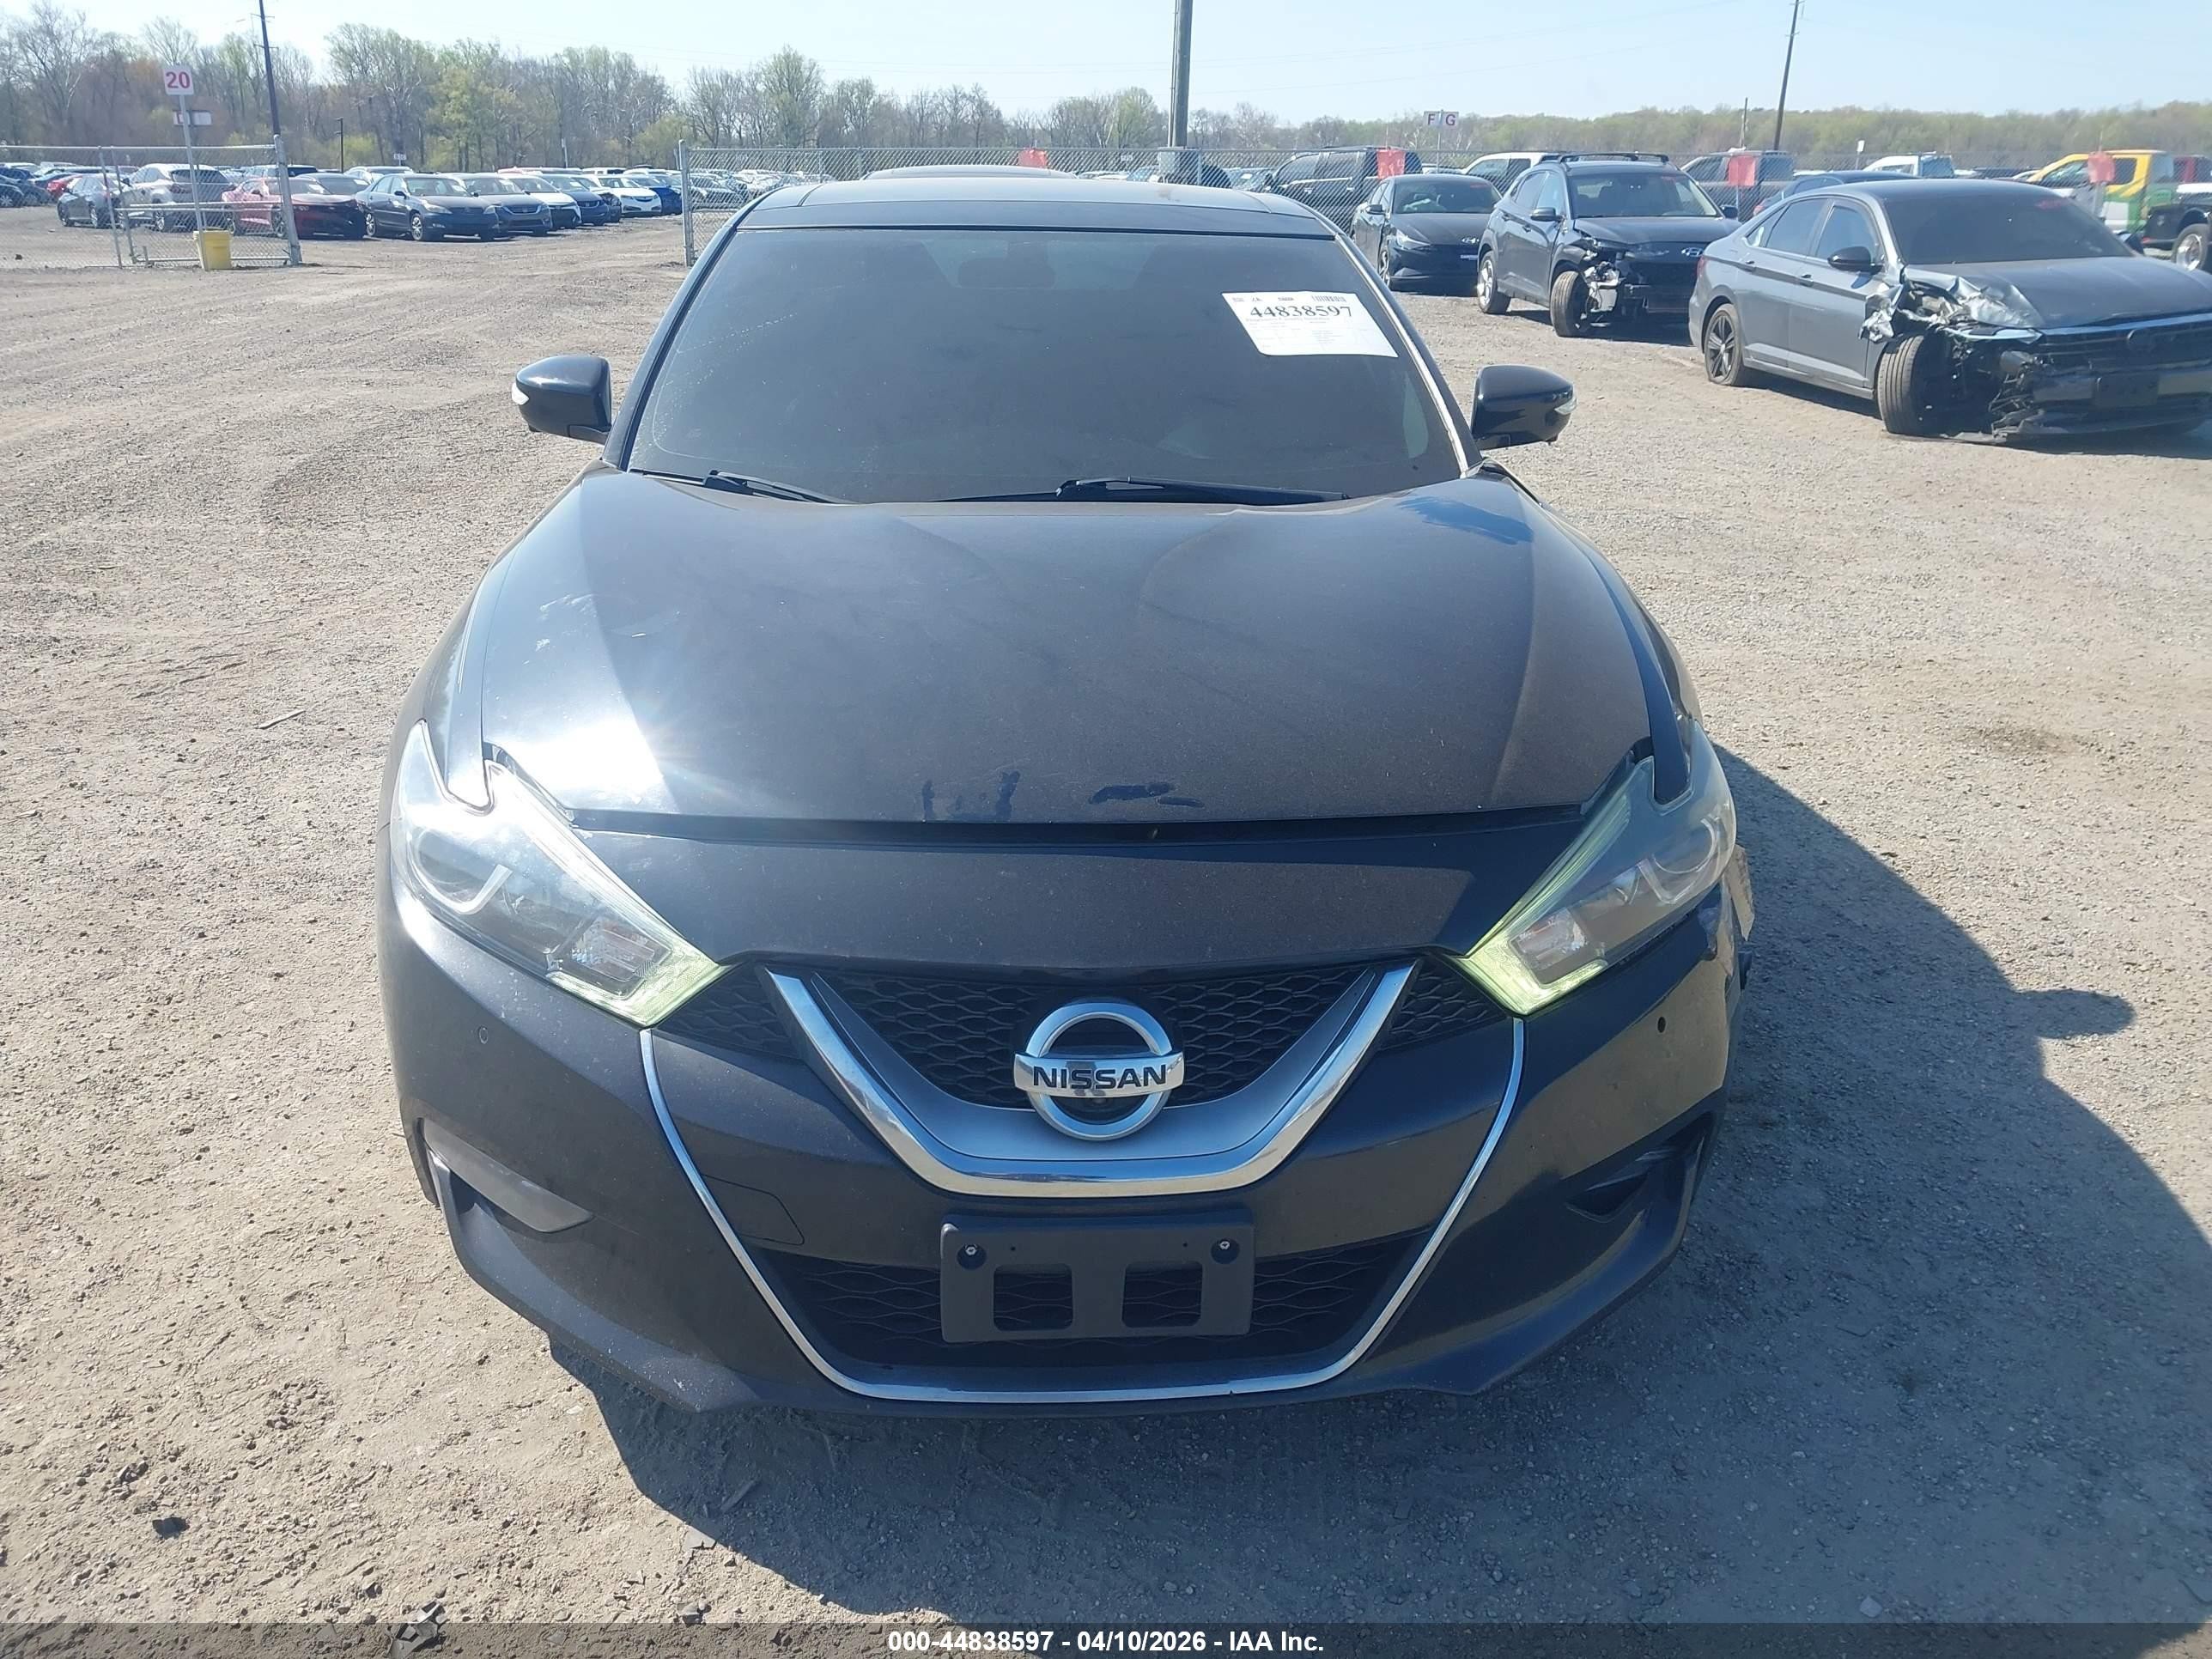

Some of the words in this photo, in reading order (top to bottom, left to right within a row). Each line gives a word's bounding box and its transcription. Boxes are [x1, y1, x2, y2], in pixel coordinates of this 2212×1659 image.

[166, 71, 190, 88] 20
[1427, 113, 1436, 125] F
[1445, 113, 1456, 126] G
[1250, 305, 1352, 318] 44838597
[1033, 1064, 1167, 1090] NISSAN
